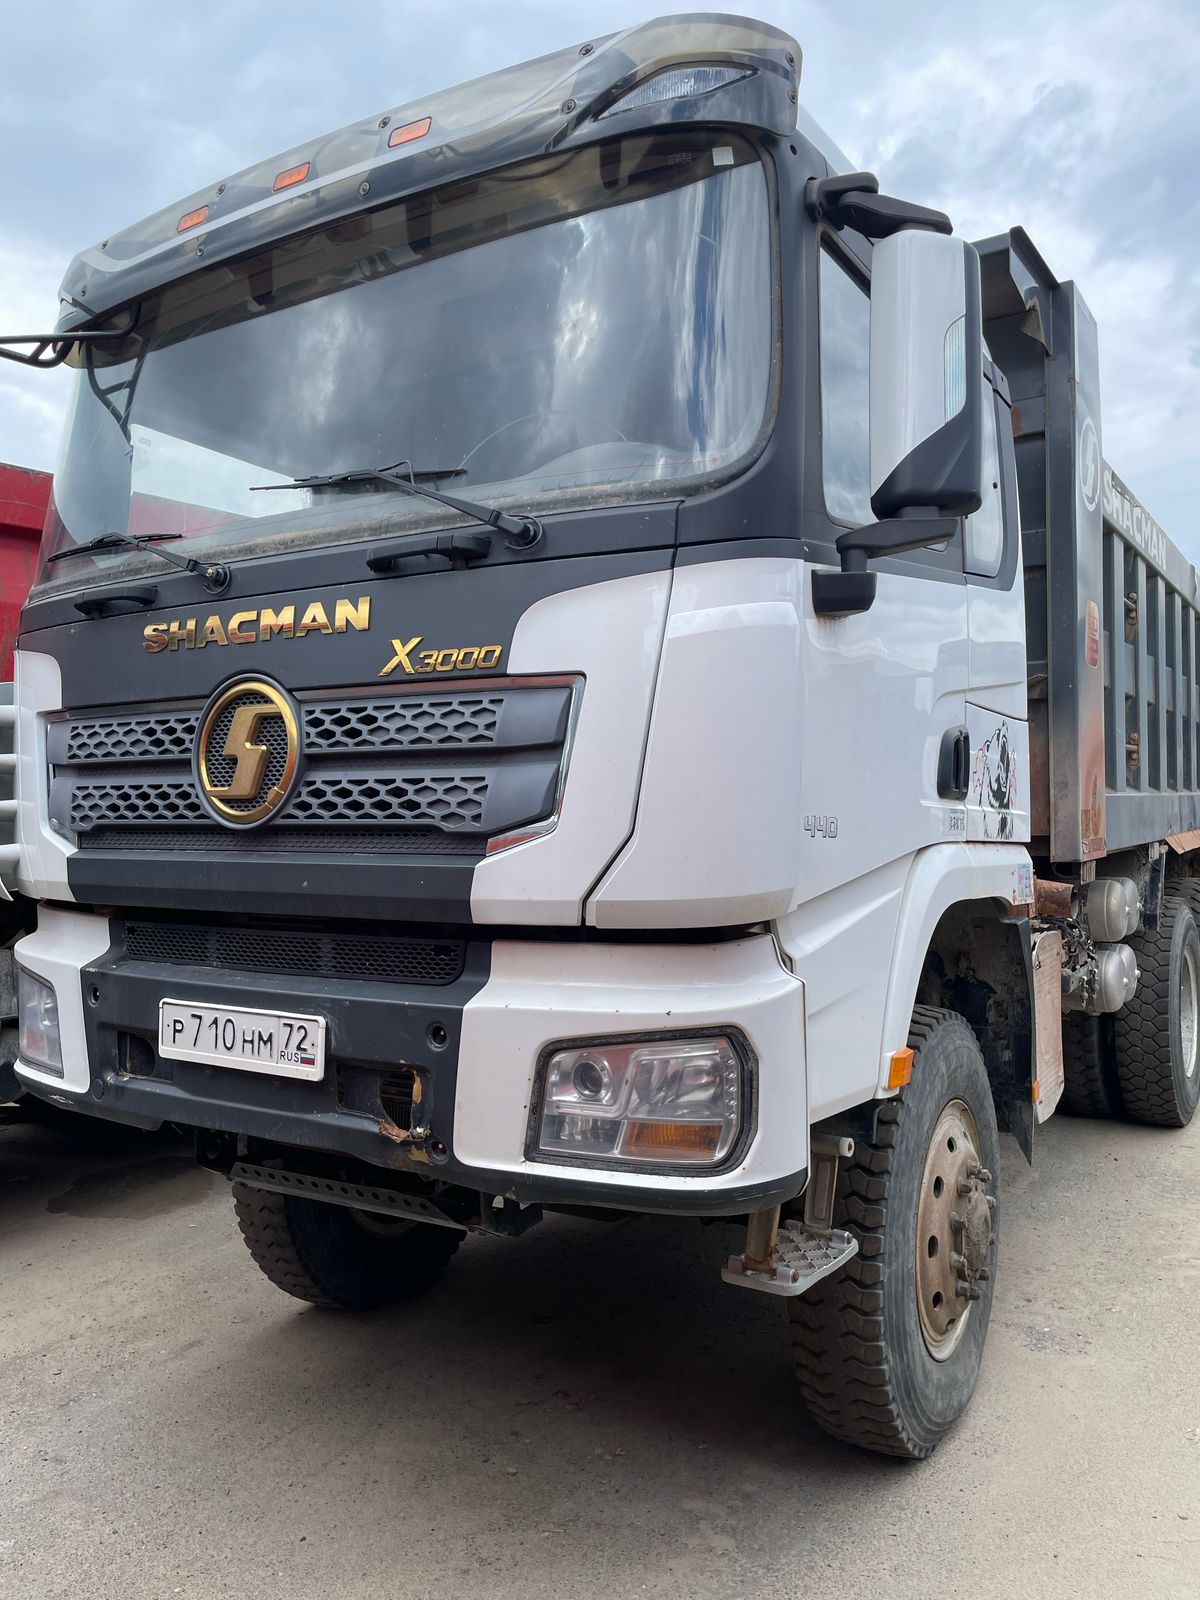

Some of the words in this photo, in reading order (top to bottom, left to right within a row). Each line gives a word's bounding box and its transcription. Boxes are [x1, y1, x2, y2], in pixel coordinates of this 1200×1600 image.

[1103, 469, 1167, 571] SHACMAN
[143, 596, 372, 653] SHACMAN
[378, 636, 503, 677] X3000
[803, 815, 838, 838] 440
[283, 1022, 309, 1052] 72
[280, 1050, 300, 1063] RUS
